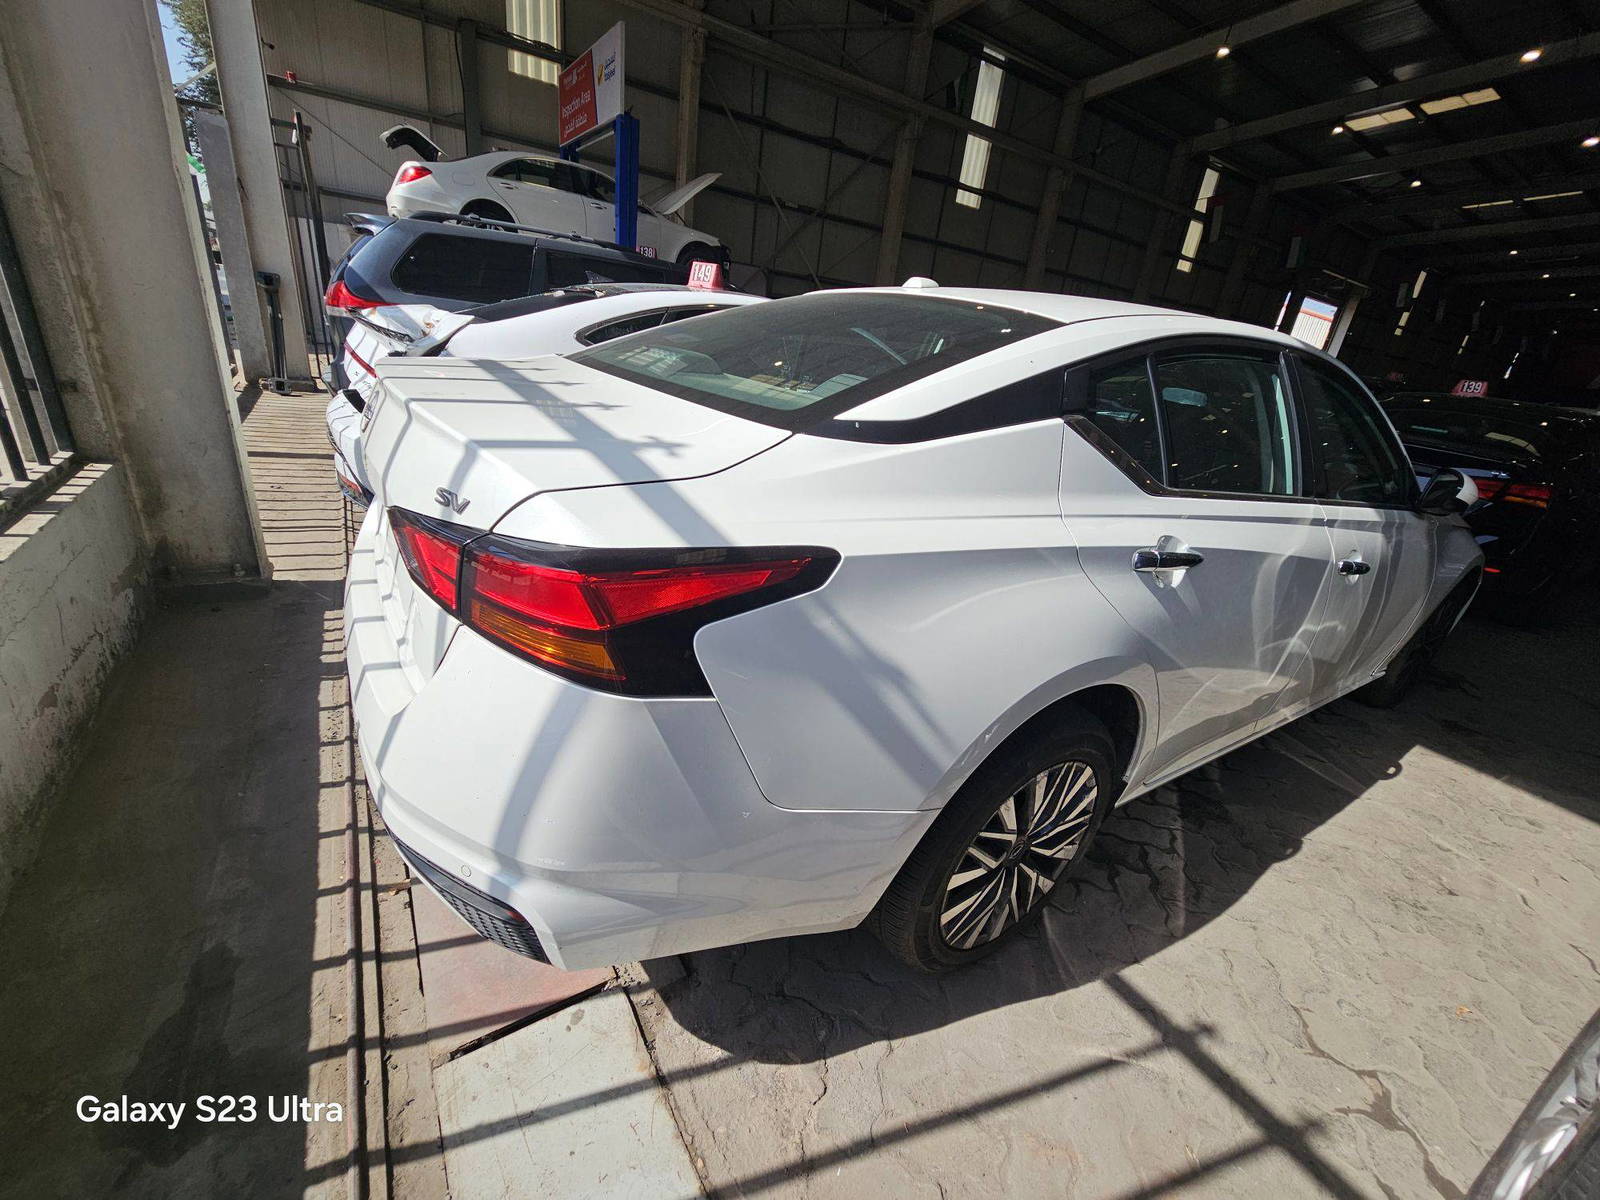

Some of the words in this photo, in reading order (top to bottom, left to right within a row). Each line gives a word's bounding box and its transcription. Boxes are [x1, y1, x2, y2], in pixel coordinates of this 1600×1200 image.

[561, 98, 581, 120] Inspection
[580, 90, 591, 105] Area
[640, 246, 653, 258] 138
[692, 263, 713, 282] 149
[1462, 381, 1482, 393] 139
[434, 486, 470, 515] SV
